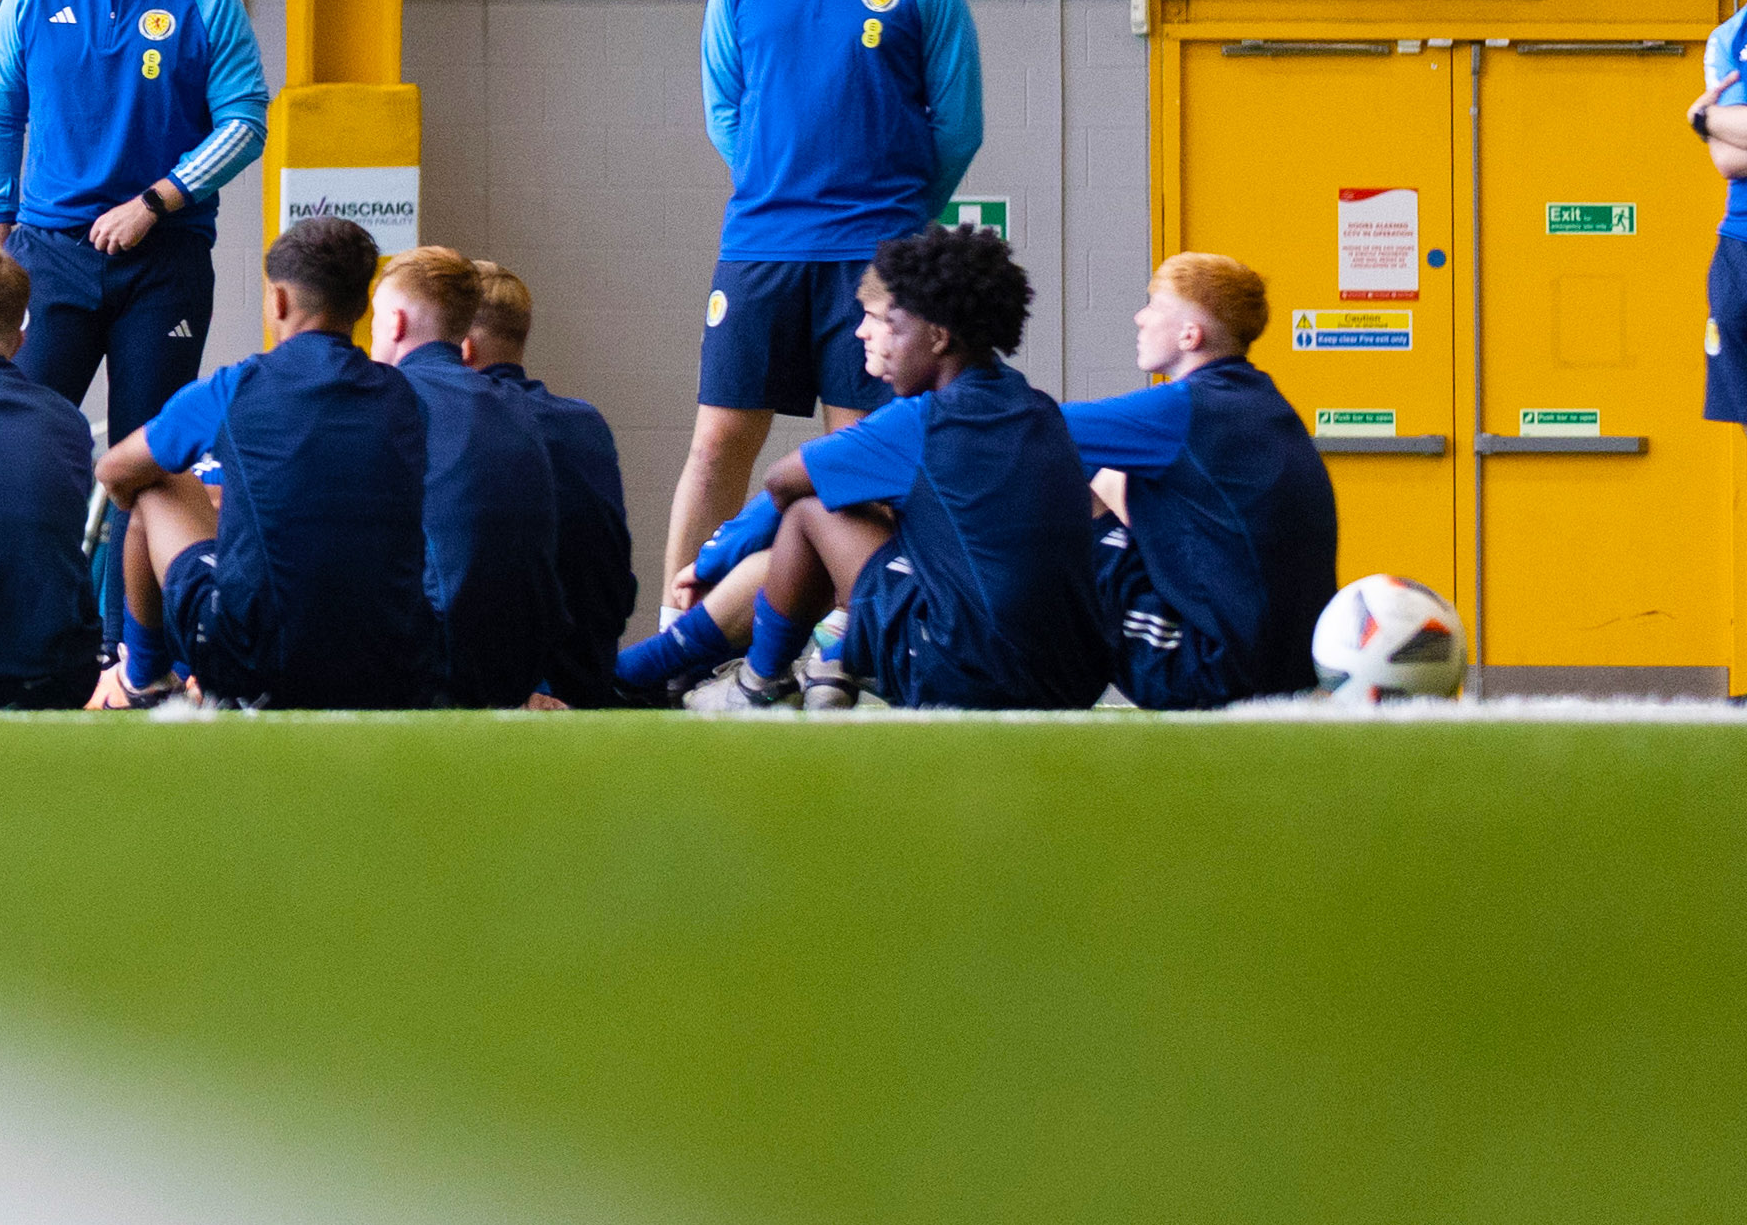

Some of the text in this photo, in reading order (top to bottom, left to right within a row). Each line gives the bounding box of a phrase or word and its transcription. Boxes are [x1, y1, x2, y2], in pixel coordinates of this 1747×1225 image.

[289, 196, 414, 217] RAVENSCRAIG
[1550, 206, 1581, 222] Exit
[1344, 313, 1381, 323] Caution
[1318, 335, 1407, 345] Keep clear Fire exit only
